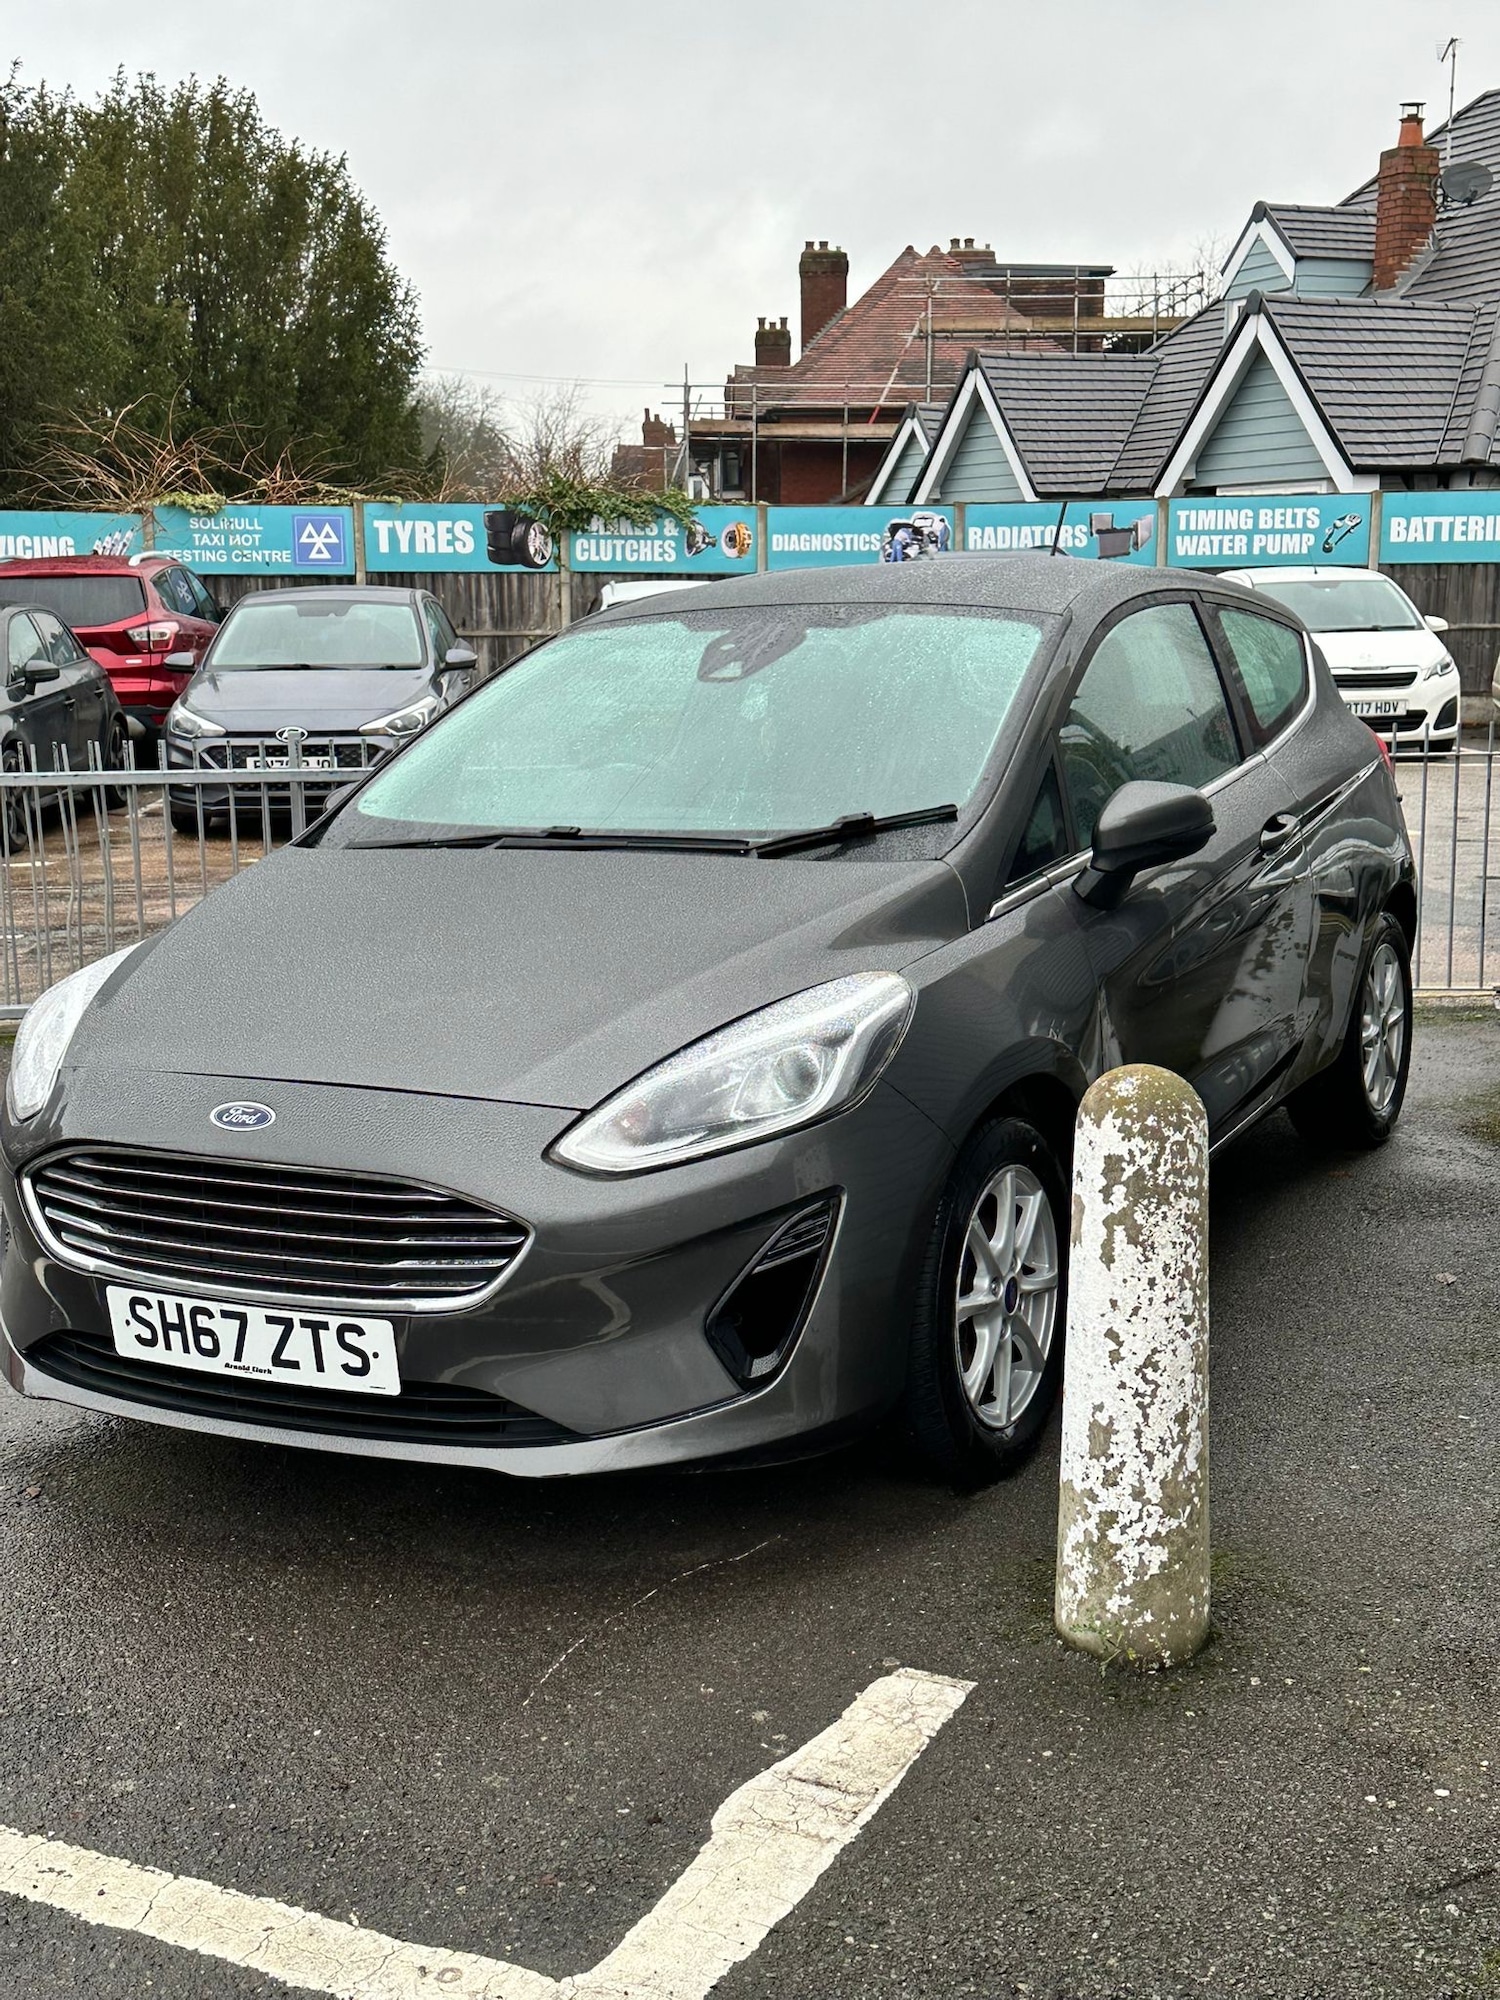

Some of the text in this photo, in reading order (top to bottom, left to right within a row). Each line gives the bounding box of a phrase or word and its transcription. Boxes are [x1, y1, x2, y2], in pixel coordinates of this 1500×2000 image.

[663, 517, 679, 537] &
[1176, 507, 1320, 531] TIMING BELTS
[192, 534, 225, 546] TAXI
[373, 520, 474, 554] TYRES
[772, 533, 882, 552] DIAGNOSTICS
[968, 525, 1088, 550] RADIATORS
[1175, 533, 1316, 556] WATER PUMP
[231, 549, 292, 562] CENTRE
[575, 538, 677, 562] CLUTCHES
[1375, 701, 1399, 714] HDV
[222, 1106, 261, 1124] Ford
[128, 1296, 371, 1377] SH67 ZTS
[224, 1362, 251, 1372] Arnold
